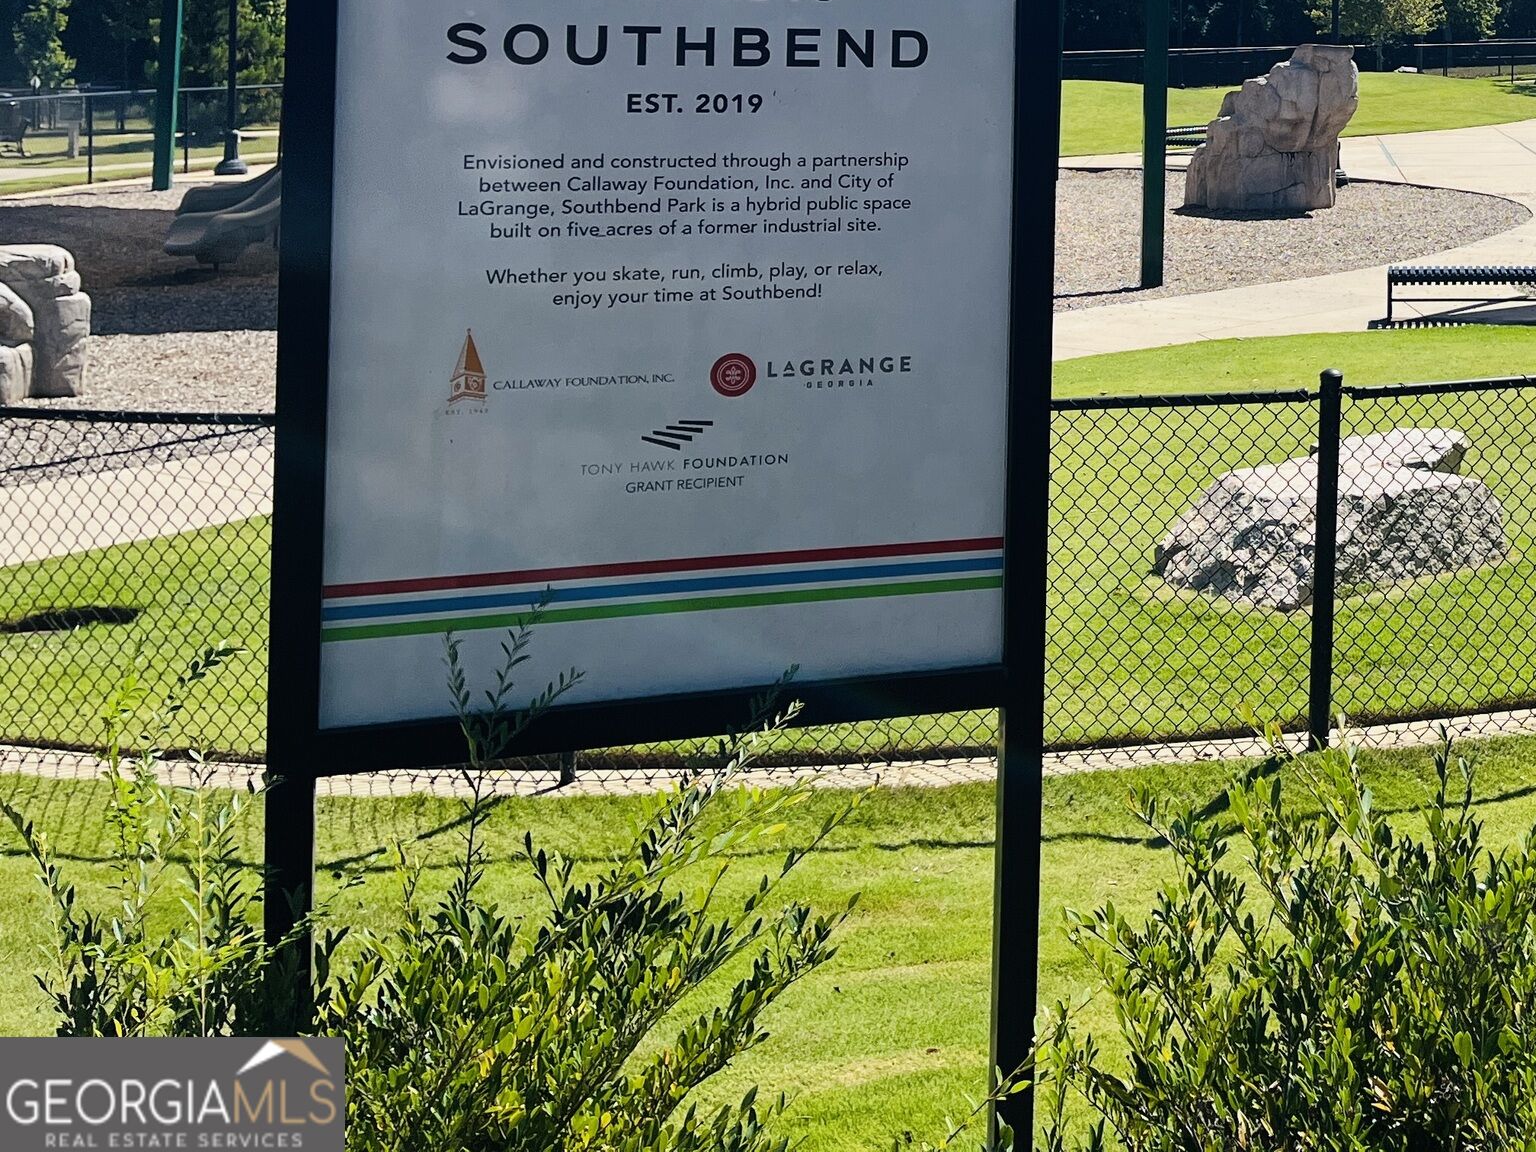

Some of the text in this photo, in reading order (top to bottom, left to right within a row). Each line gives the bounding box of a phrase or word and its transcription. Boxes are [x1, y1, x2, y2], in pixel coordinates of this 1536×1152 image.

[445, 22, 930, 69] SOUTHBEND
[626, 93, 763, 114] EST. 2019
[464, 152, 909, 172] Envisioned and constructed through a partnership
[480, 173, 894, 196] between Callaway Foundation, Inc. and City of
[458, 195, 912, 220] LaGrange, Southbend Park is a hybrid public space
[490, 217, 882, 239] built on five acres of a former industrial site.
[486, 260, 883, 287] Whether you skate, run, climb, play, or relax,
[552, 283, 822, 309] enjoy your time at Southbend!
[492, 373, 676, 391] CALLAWAY FOUNDATION, INC.
[806, 378, 873, 389] GEORGIA
[581, 454, 789, 476] TONY HAWK FOUNDATION
[626, 476, 745, 494] GRANT RECIPIENT
